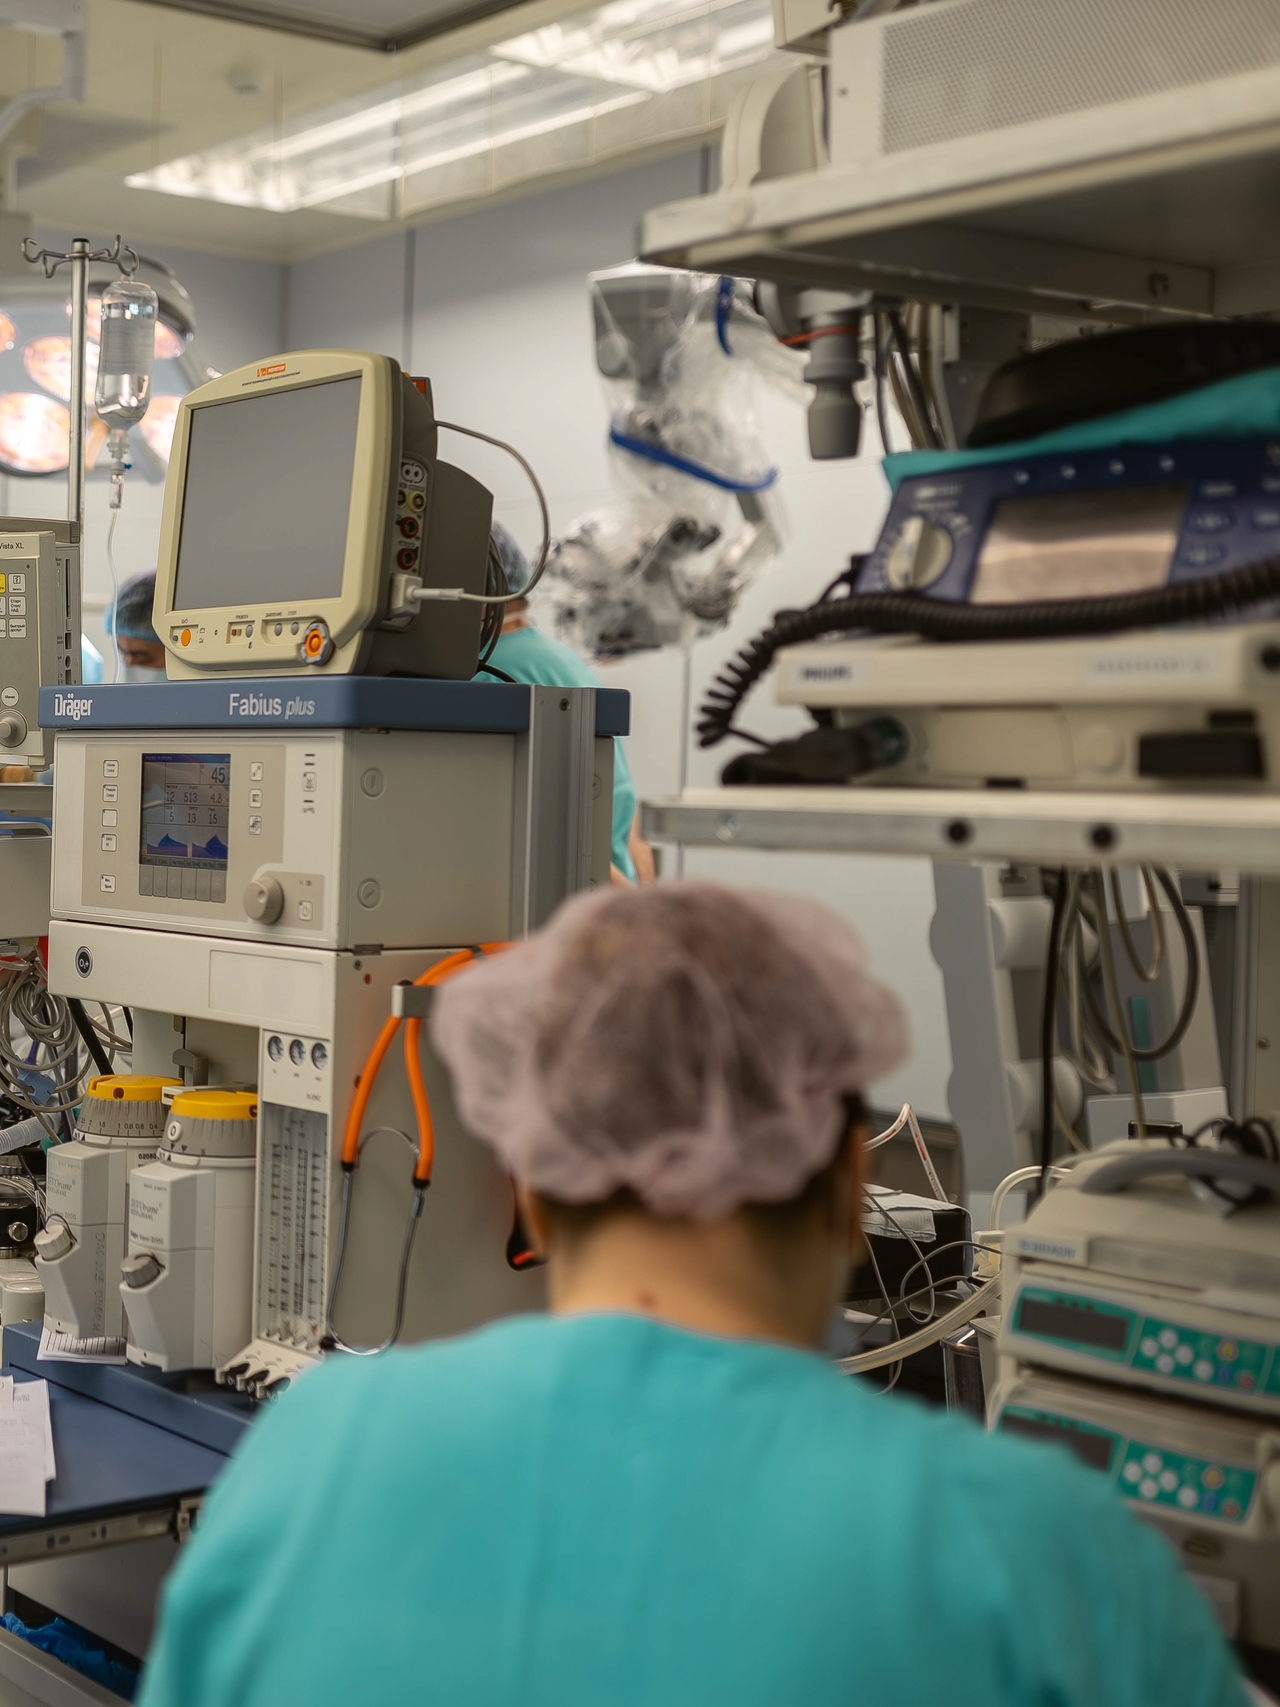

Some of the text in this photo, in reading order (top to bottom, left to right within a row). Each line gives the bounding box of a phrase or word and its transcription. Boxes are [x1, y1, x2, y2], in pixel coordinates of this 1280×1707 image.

[54, 692, 93, 721] Dräger
[229, 692, 316, 720] Fabius plus
[211, 767, 226, 784] 45
[166, 791, 223, 804] 12 513 4.8
[169, 811, 218, 825] 5 13 15
